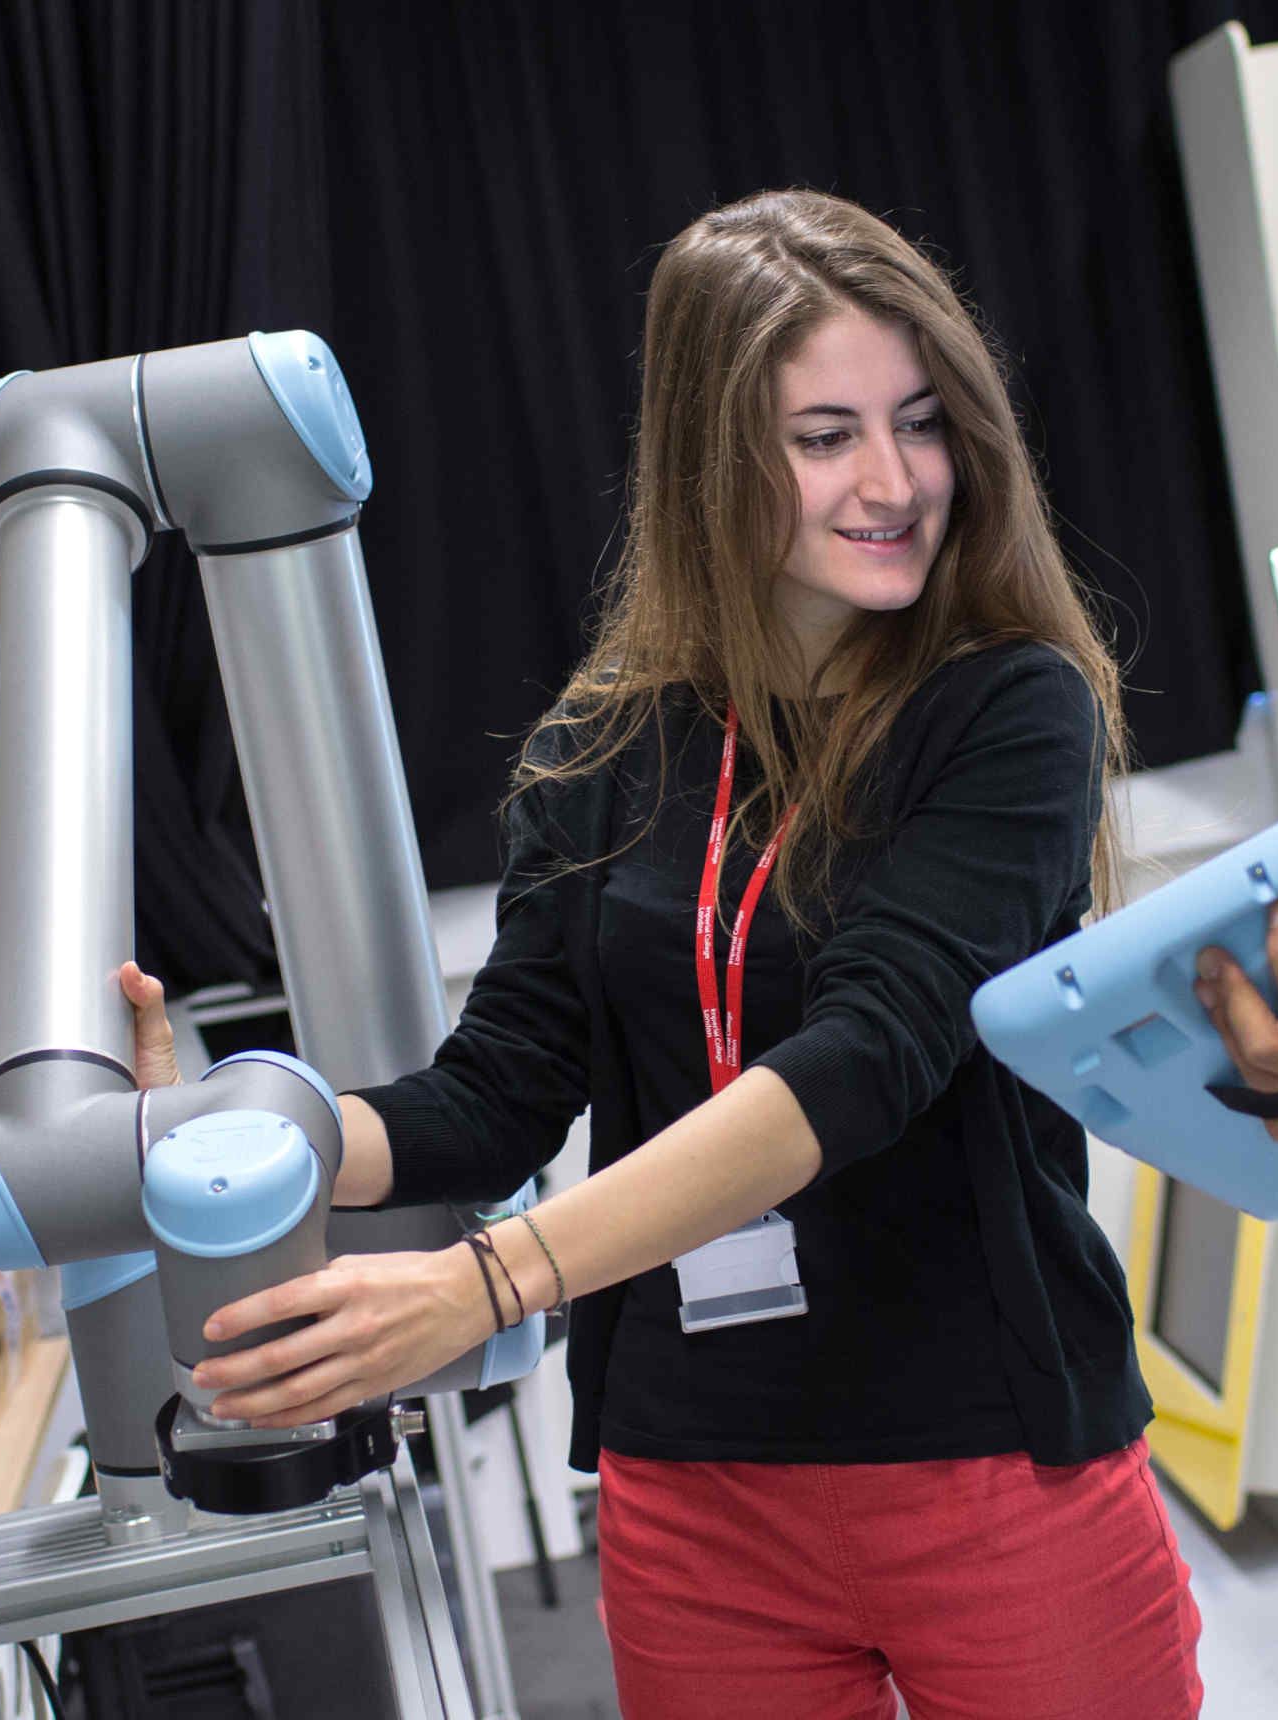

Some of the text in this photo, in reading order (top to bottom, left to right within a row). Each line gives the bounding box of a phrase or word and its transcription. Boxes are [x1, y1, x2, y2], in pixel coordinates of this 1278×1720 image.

[711, 816, 725, 865] Imperial College
[696, 907, 705, 935] London
[703, 906, 713, 960] Imperial College
[728, 910, 745, 965] Imperial College
[734, 937, 744, 966] London
[704, 1009, 713, 1038] London
[710, 1008, 723, 1064] Imperial College
